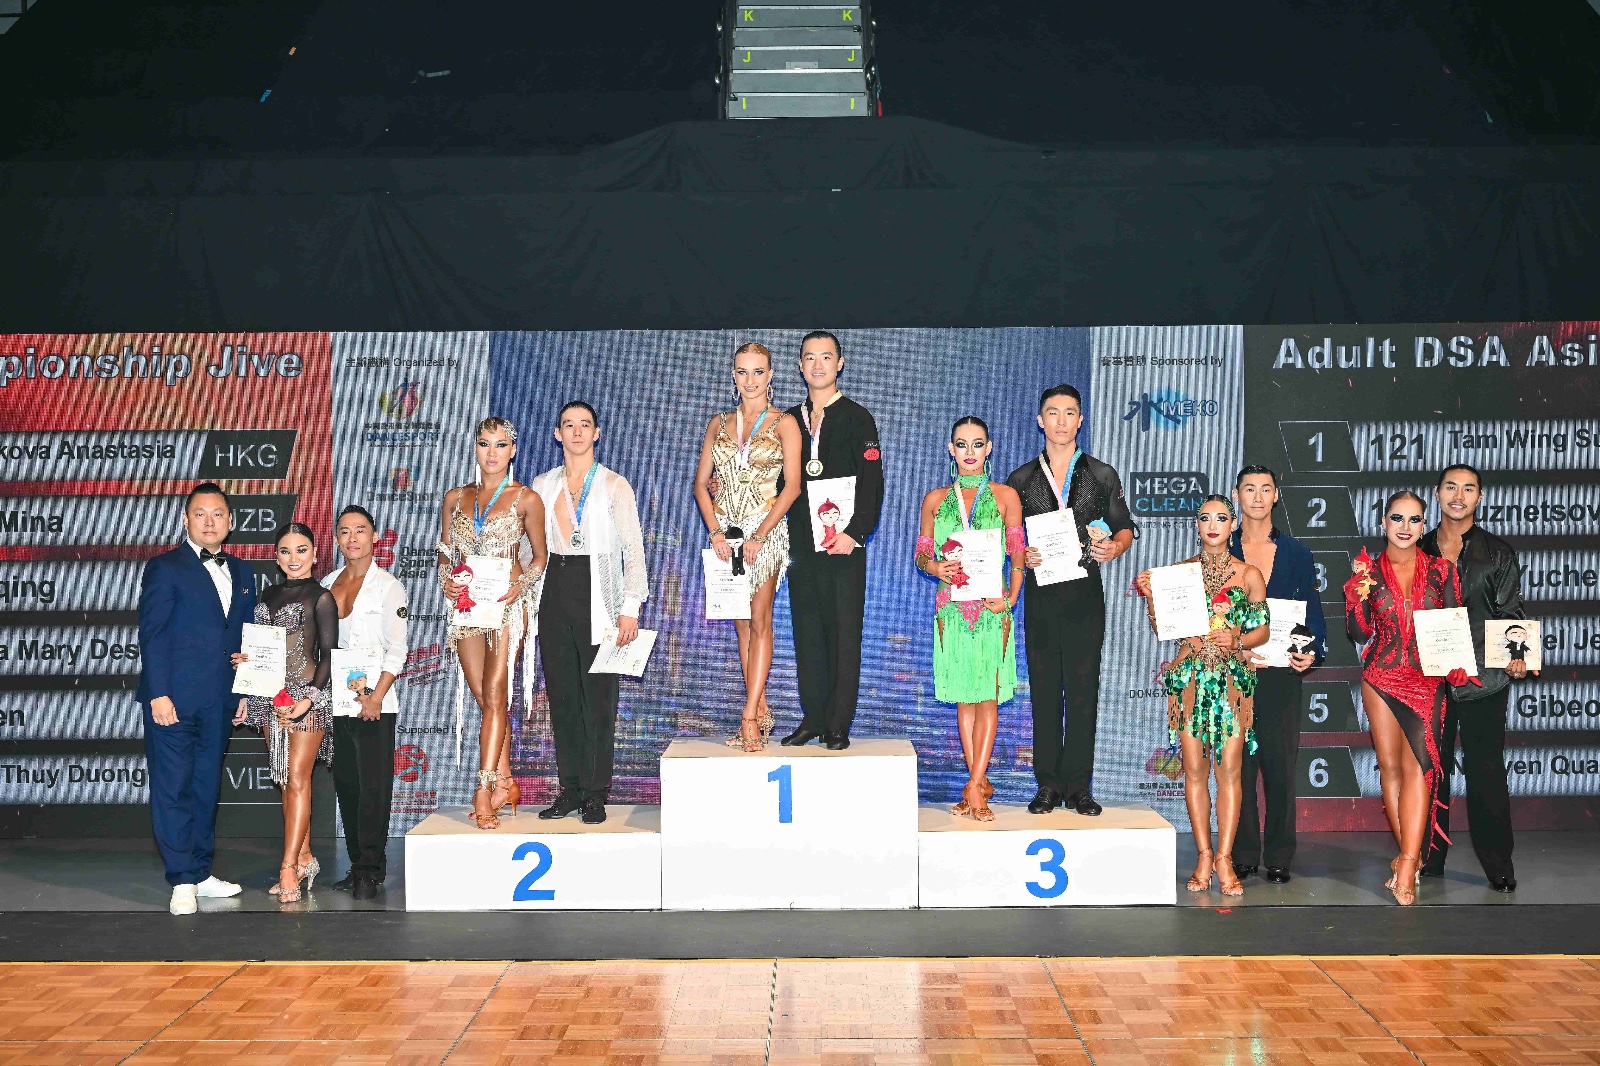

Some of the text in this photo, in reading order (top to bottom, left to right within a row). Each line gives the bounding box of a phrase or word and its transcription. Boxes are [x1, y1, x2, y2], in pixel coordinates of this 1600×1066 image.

[744, 10, 754, 21] K
[843, 10, 853, 21] K
[743, 51, 751, 63] J
[847, 50, 855, 62] J
[393, 357, 445, 369] Organized
[447, 357, 459, 369] by
[1150, 356, 1208, 368] Sponsored
[1210, 356, 1223, 367] by
[1273, 334, 1599, 369] Adult DSA Asi
[0, 344, 303, 387] pionship Jive
[1162, 400, 1218, 417] MEKO
[57, 440, 176, 460] Anastasia
[1308, 432, 1324, 463] 1
[1370, 434, 1425, 460] 121
[1449, 429, 1600, 452] Tam Wing Su
[214, 444, 278, 468] HKG
[1135, 477, 1203, 495] MEGA
[0, 510, 63, 533] Mina
[1306, 497, 1328, 528] 2
[1474, 499, 1600, 522] uznetsov
[398, 568, 428, 579] Asia
[400, 556, 435, 568] Sport
[1541, 628, 1565, 650] el
[1573, 628, 1600, 651] Je
[18, 639, 82, 665] Mary
[91, 638, 140, 660] Des
[1308, 693, 1329, 723] 5
[1516, 694, 1600, 718] Gibeo
[396, 725, 449, 736] Supported
[0, 764, 147, 789] Thuy Duong
[1308, 758, 1330, 788] 6
[1550, 754, 1599, 776] Qua
[225, 767, 274, 790] VIE
[767, 764, 793, 824] 1
[511, 841, 556, 901] 2
[1025, 838, 1069, 898] 3
